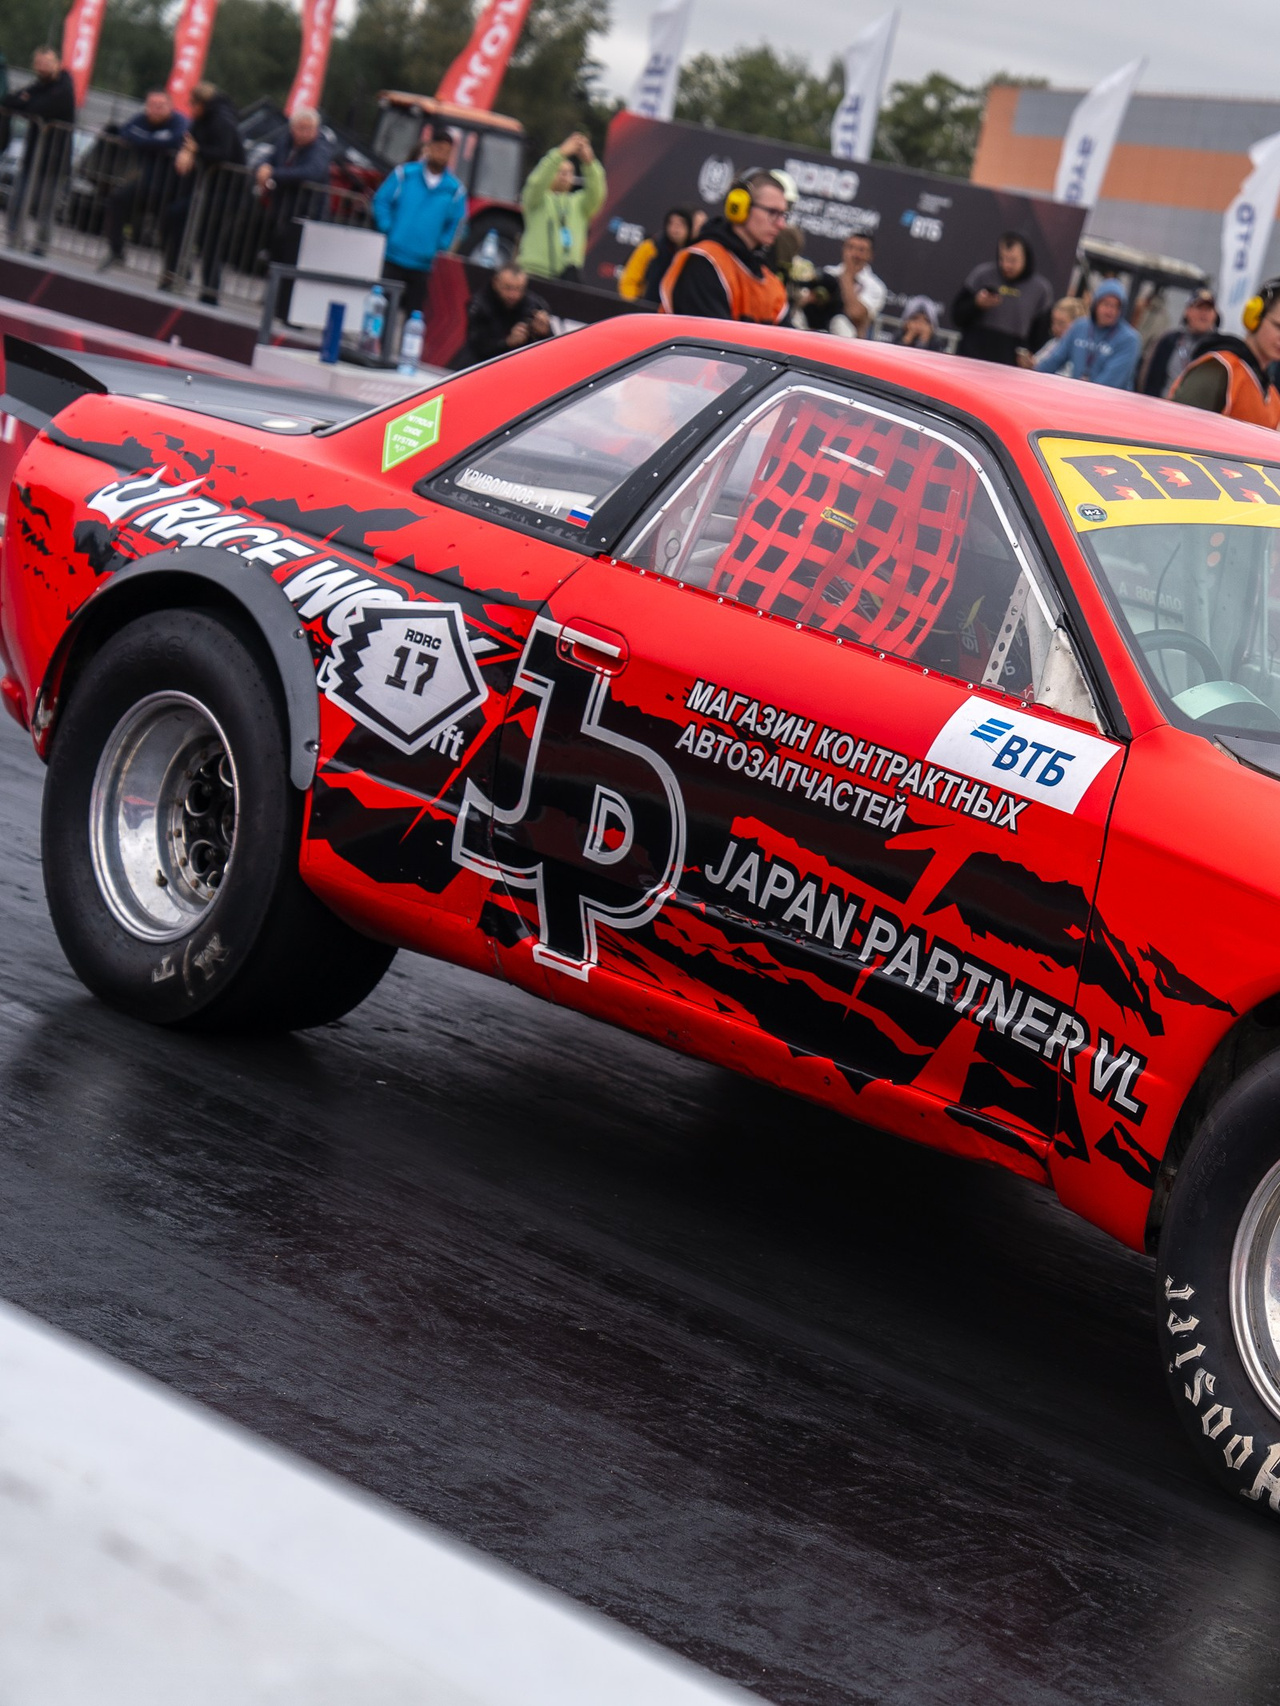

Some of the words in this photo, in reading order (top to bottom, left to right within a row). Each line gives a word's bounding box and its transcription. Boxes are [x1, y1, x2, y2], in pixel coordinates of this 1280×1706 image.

[384, 644, 439, 697] 17
[404, 628, 442, 651] RDRC
[675, 723, 908, 833] АВТОЗАПЧАСТЕЙ
[686, 680, 815, 750] МАГАЗИН
[814, 729, 1028, 831] КОНТРАКТНЫХ
[992, 735, 1077, 788] ВТБ
[704, 841, 857, 949] JAPAN
[858, 916, 1085, 1073] PARTNER
[1093, 1037, 1140, 1114] VL
